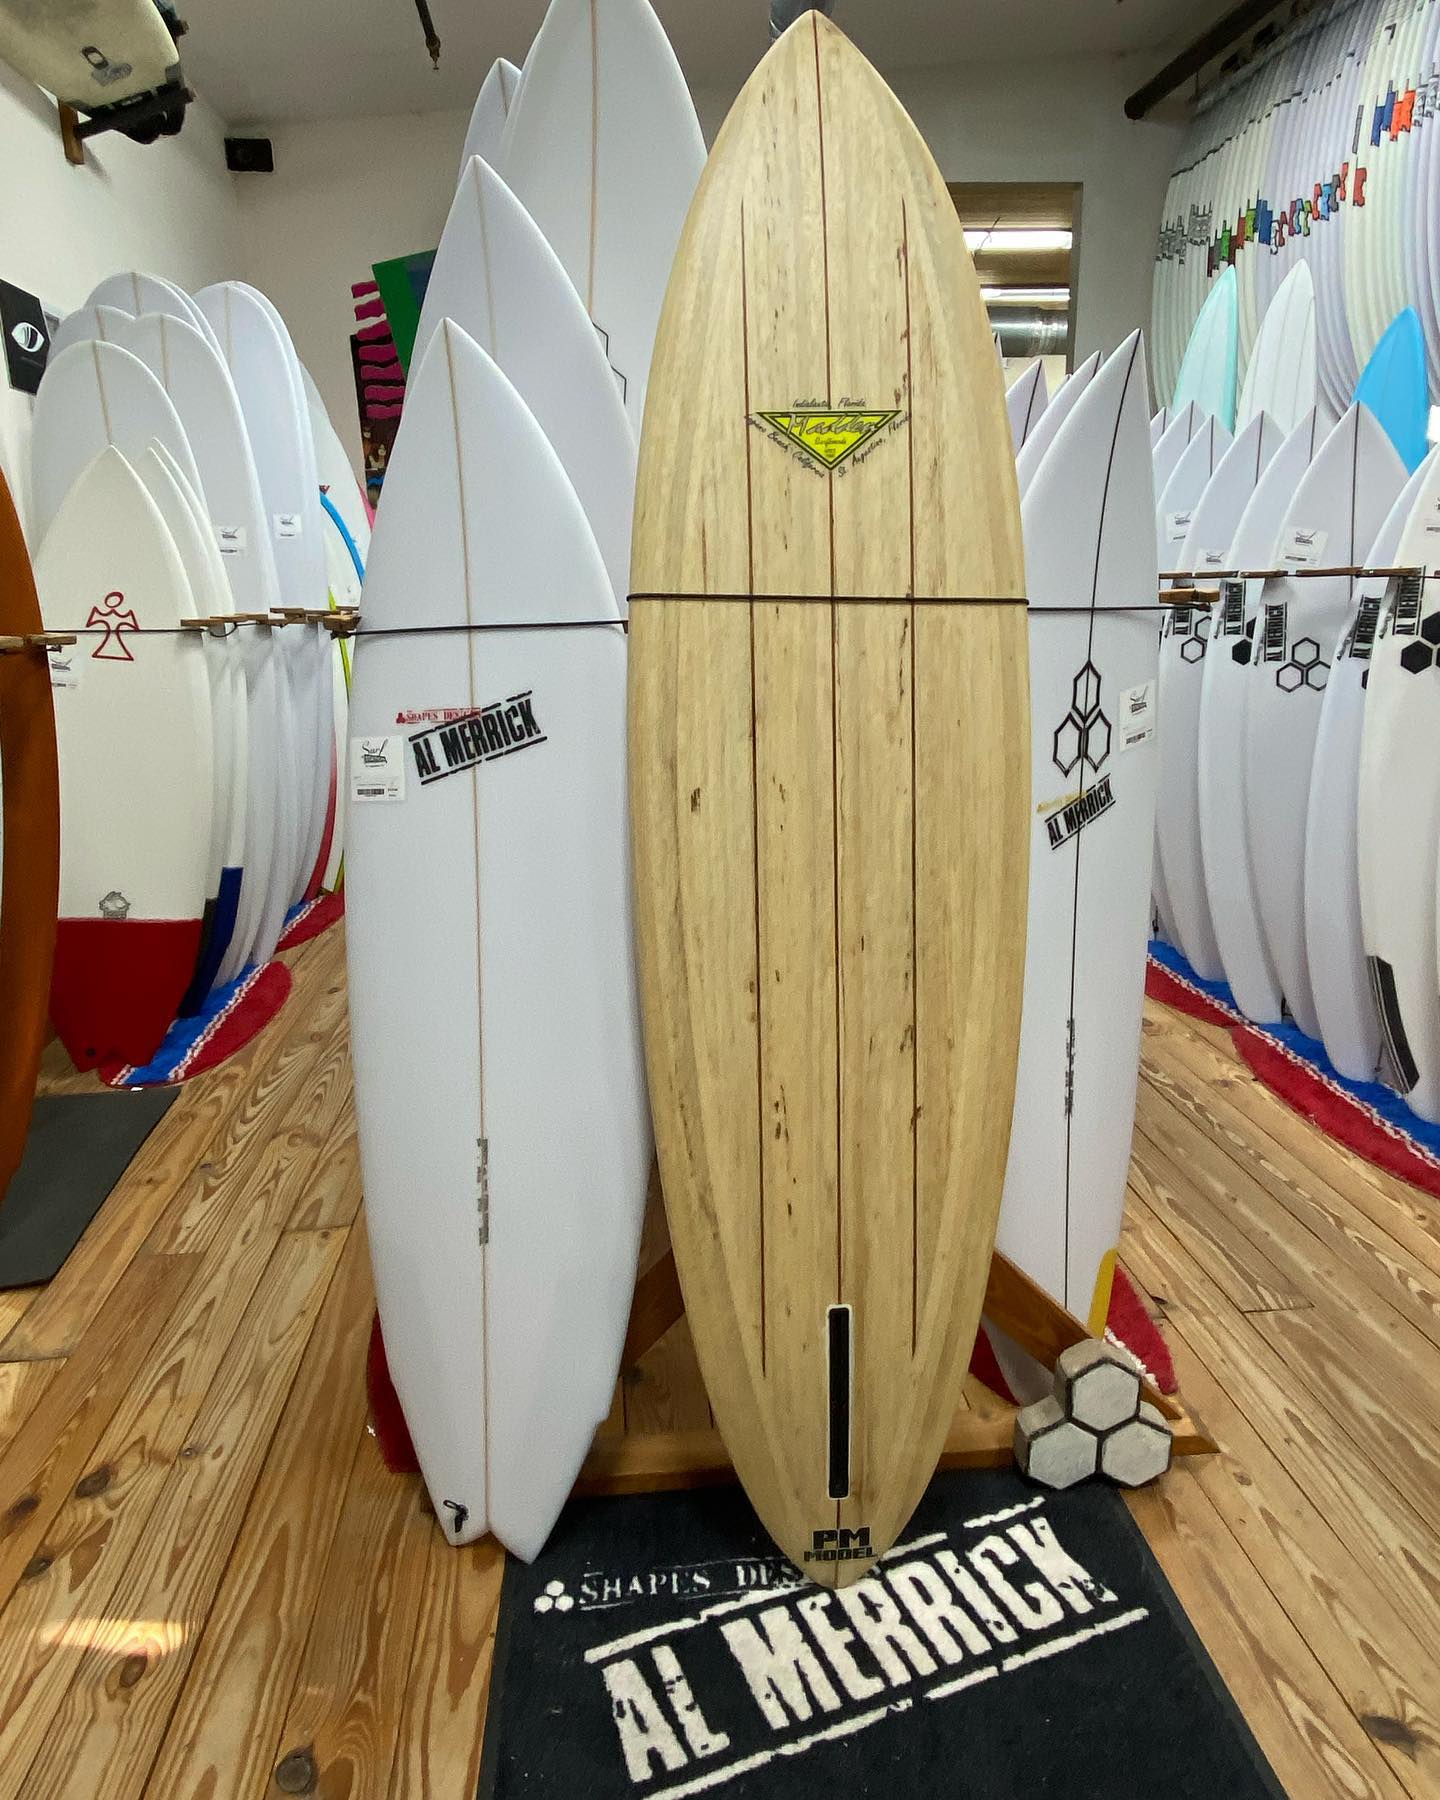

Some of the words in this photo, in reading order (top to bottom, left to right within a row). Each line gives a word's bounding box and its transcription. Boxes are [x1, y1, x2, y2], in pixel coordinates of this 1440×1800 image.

[1267, 604, 1283, 647] MERRICK
[413, 737, 440, 778] AL
[439, 699, 541, 767] MERRICK
[1047, 817, 1063, 846] AL
[1063, 779, 1114, 834] MERRICK
[803, 1547, 878, 1561] MODEL
[813, 1527, 870, 1550] PM
[600, 1645, 730, 1783] AL
[720, 1516, 1119, 1731] MERRICK
